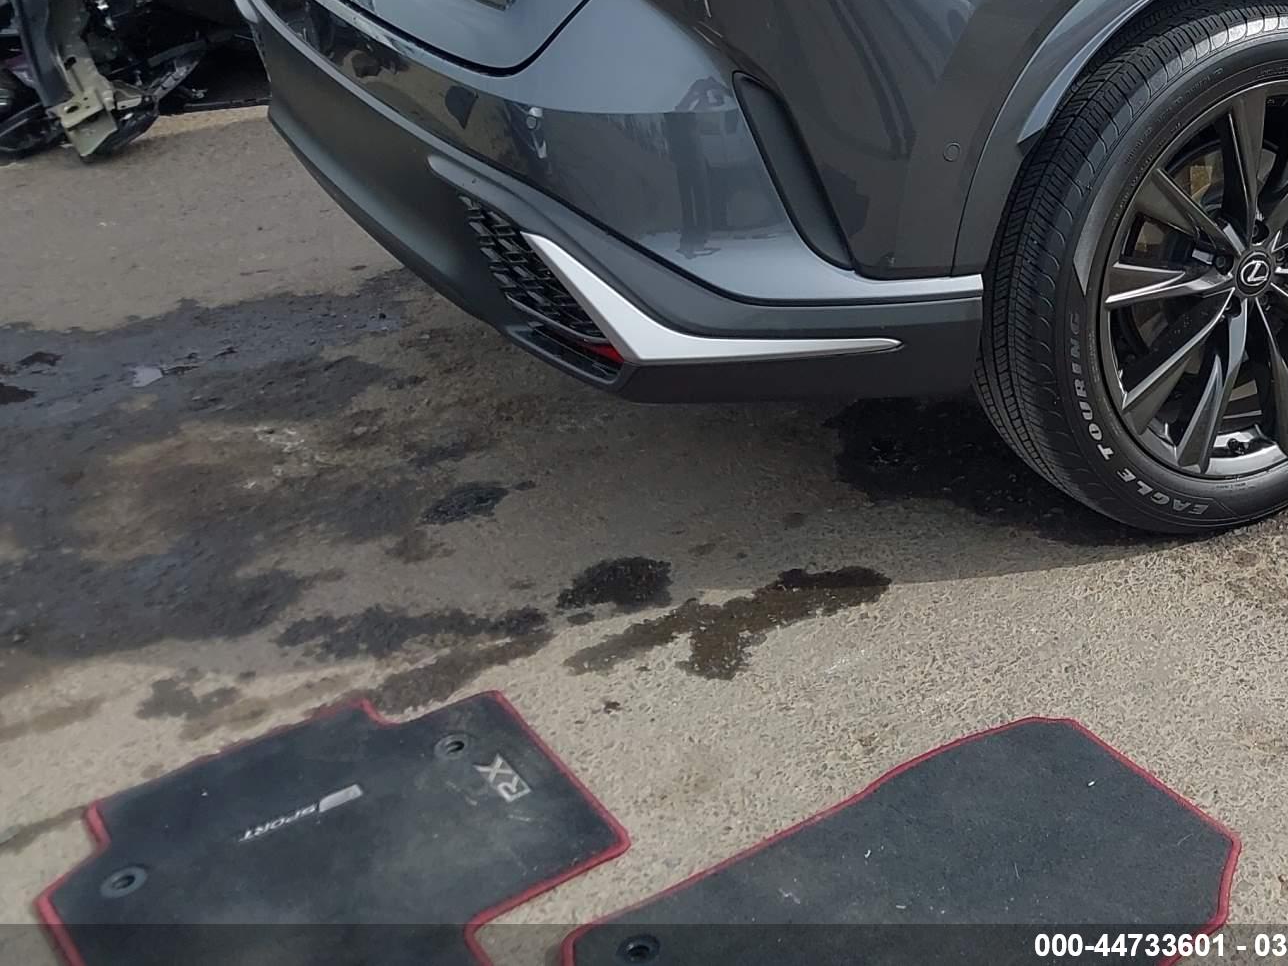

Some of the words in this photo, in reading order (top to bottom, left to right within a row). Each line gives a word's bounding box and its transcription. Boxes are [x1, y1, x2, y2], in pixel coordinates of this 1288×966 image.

[1069, 311, 1116, 462] TOURING
[1116, 467, 1210, 516] EAGLE
[473, 753, 532, 803] RX
